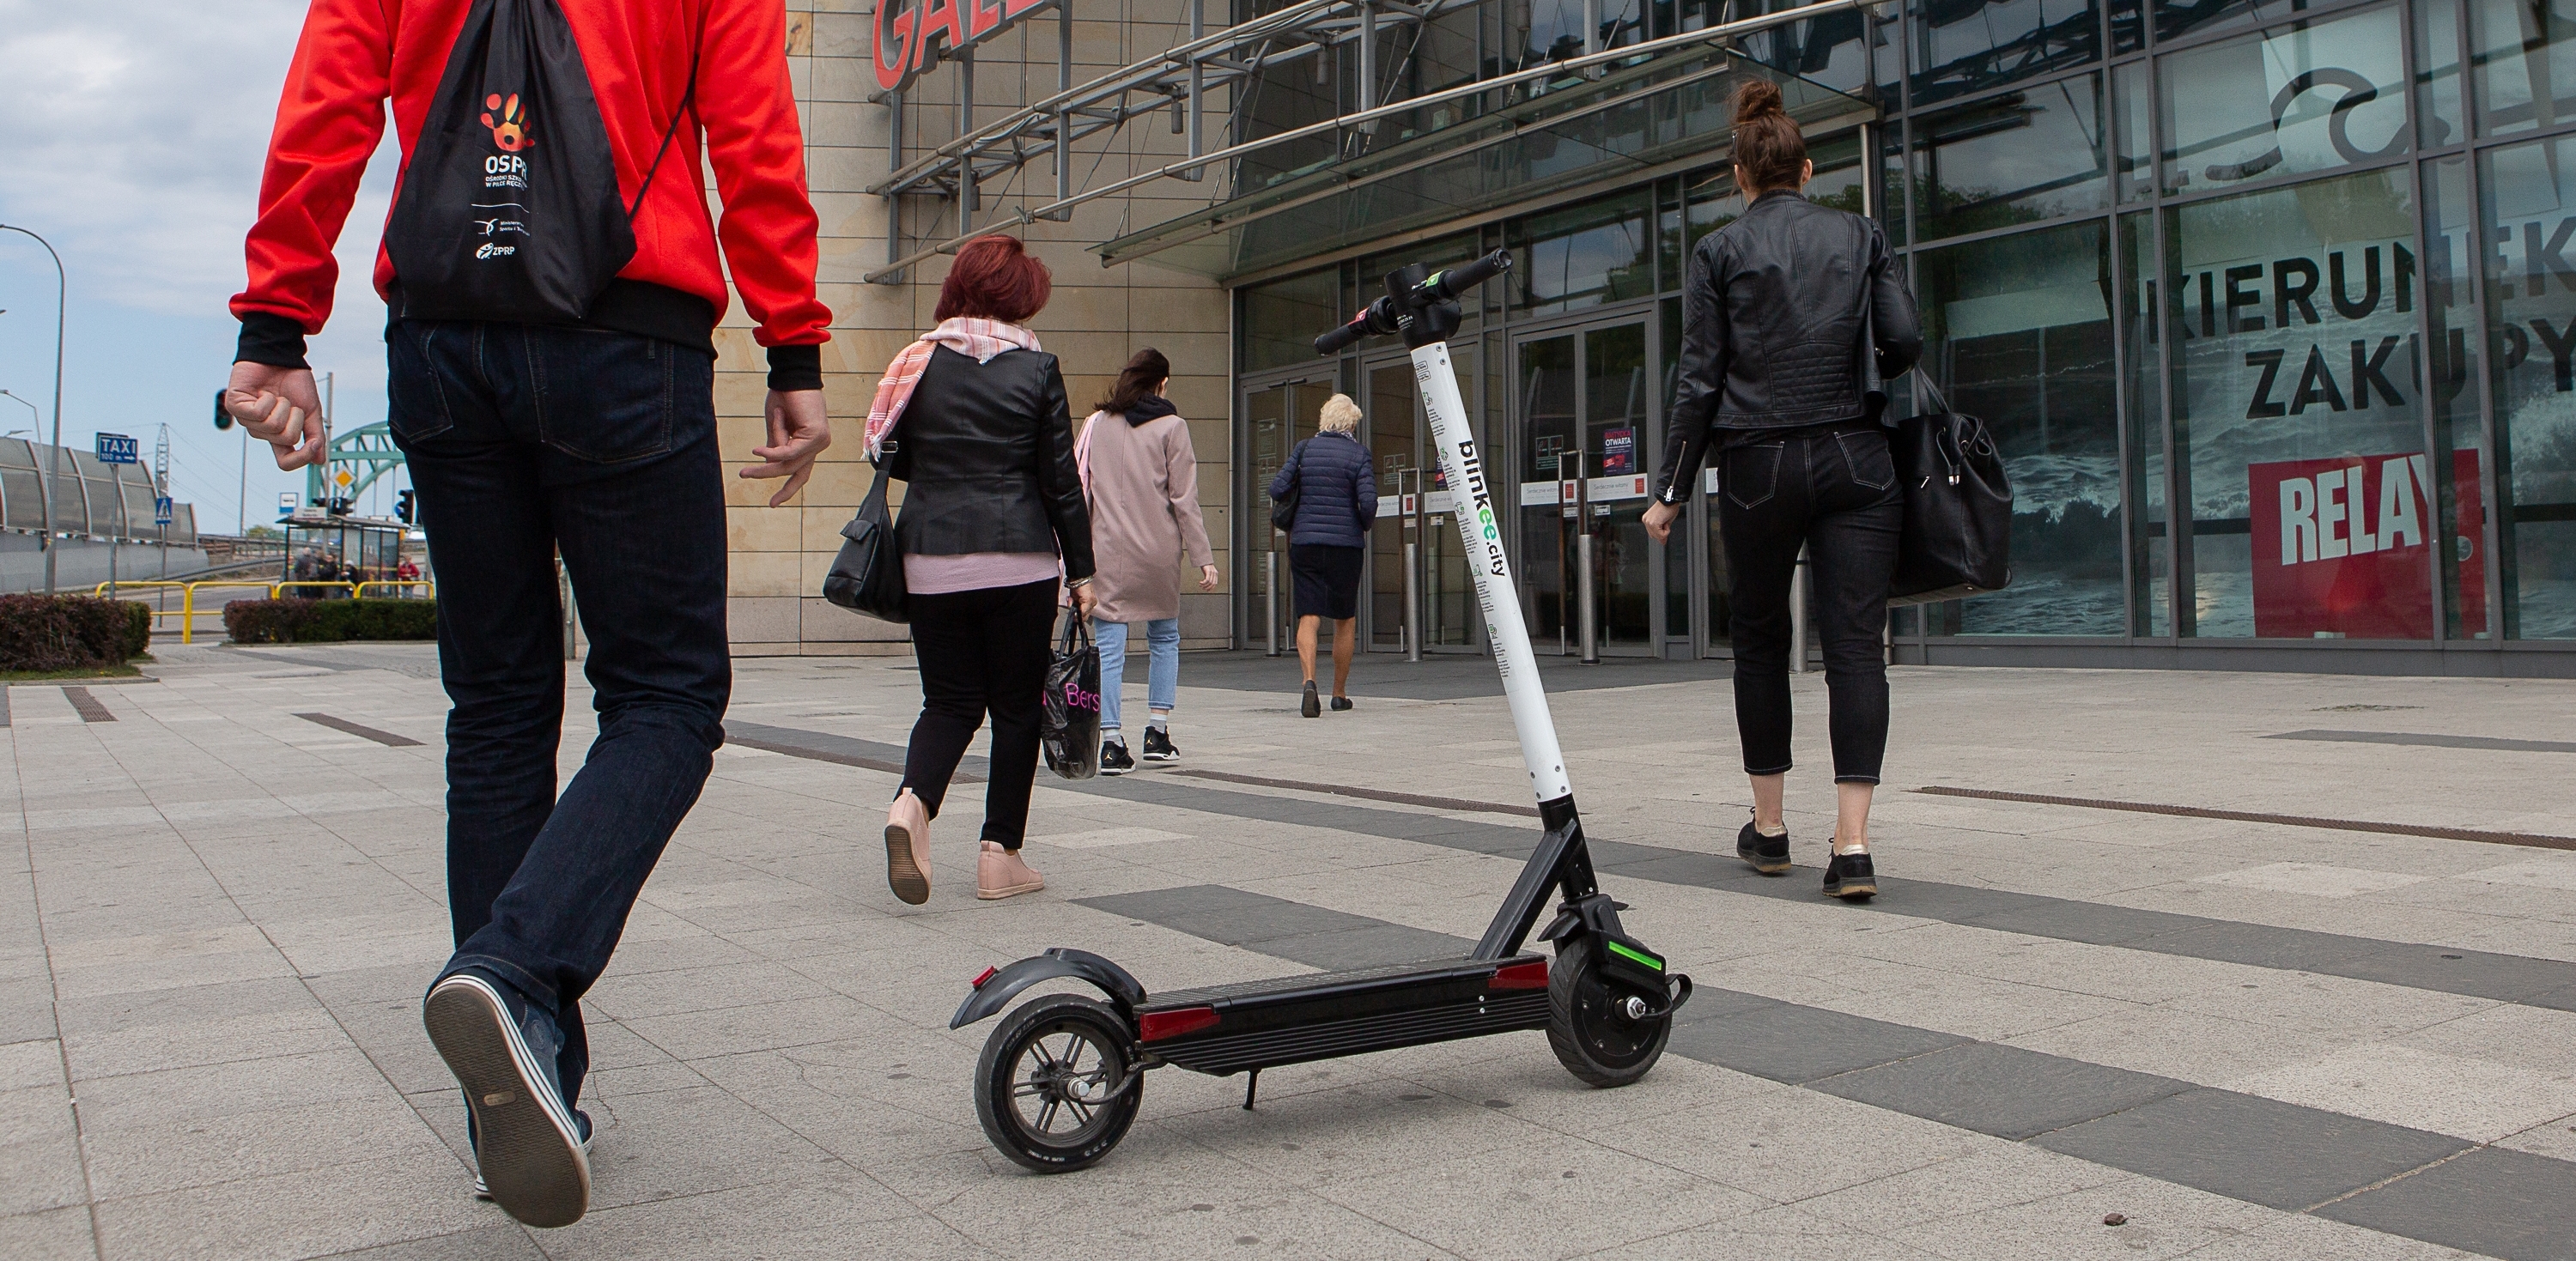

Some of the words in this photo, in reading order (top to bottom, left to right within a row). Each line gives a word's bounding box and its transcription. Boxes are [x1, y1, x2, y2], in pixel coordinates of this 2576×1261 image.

[493, 246, 515, 256] ZPRP
[101, 439, 136, 454] TAXI
[1606, 437, 1631, 446] OTWARTA
[1458, 440, 1505, 577] blinkee.city
[1066, 682, 1100, 712] Bers
